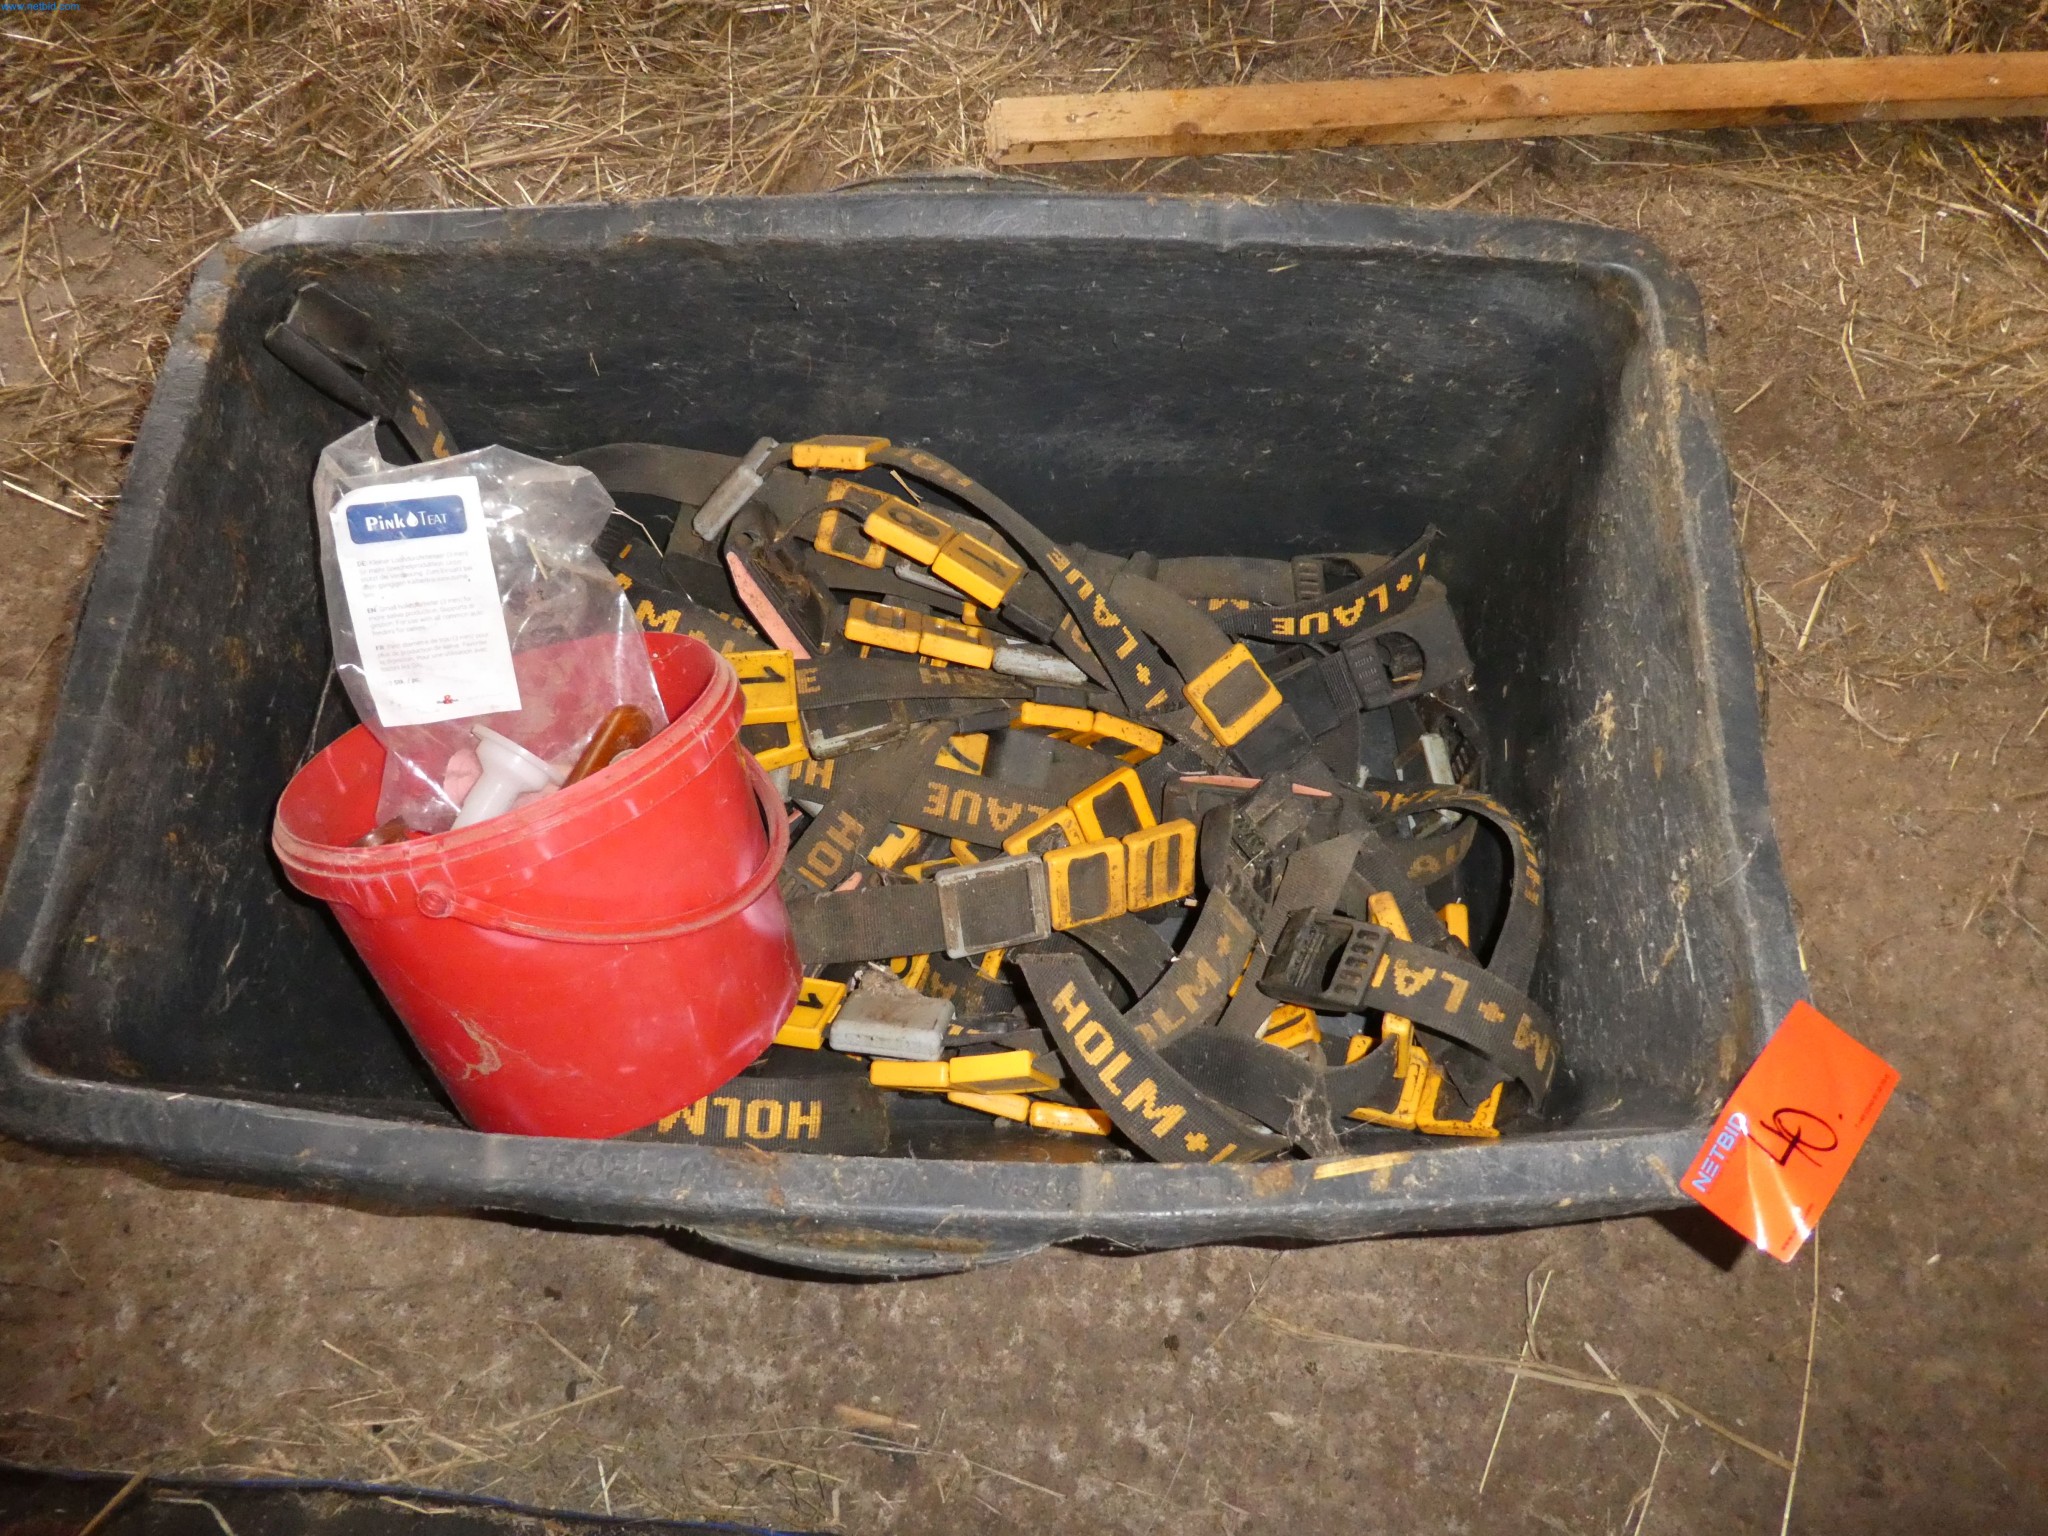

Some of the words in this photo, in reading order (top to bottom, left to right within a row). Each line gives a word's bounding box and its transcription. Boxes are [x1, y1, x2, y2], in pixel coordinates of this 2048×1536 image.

[1046, 547, 1139, 661] LAUE
[1271, 582, 1390, 637] LAUE
[1051, 981, 1188, 1140] HOLM
[1691, 1112, 1749, 1193] NETBID
